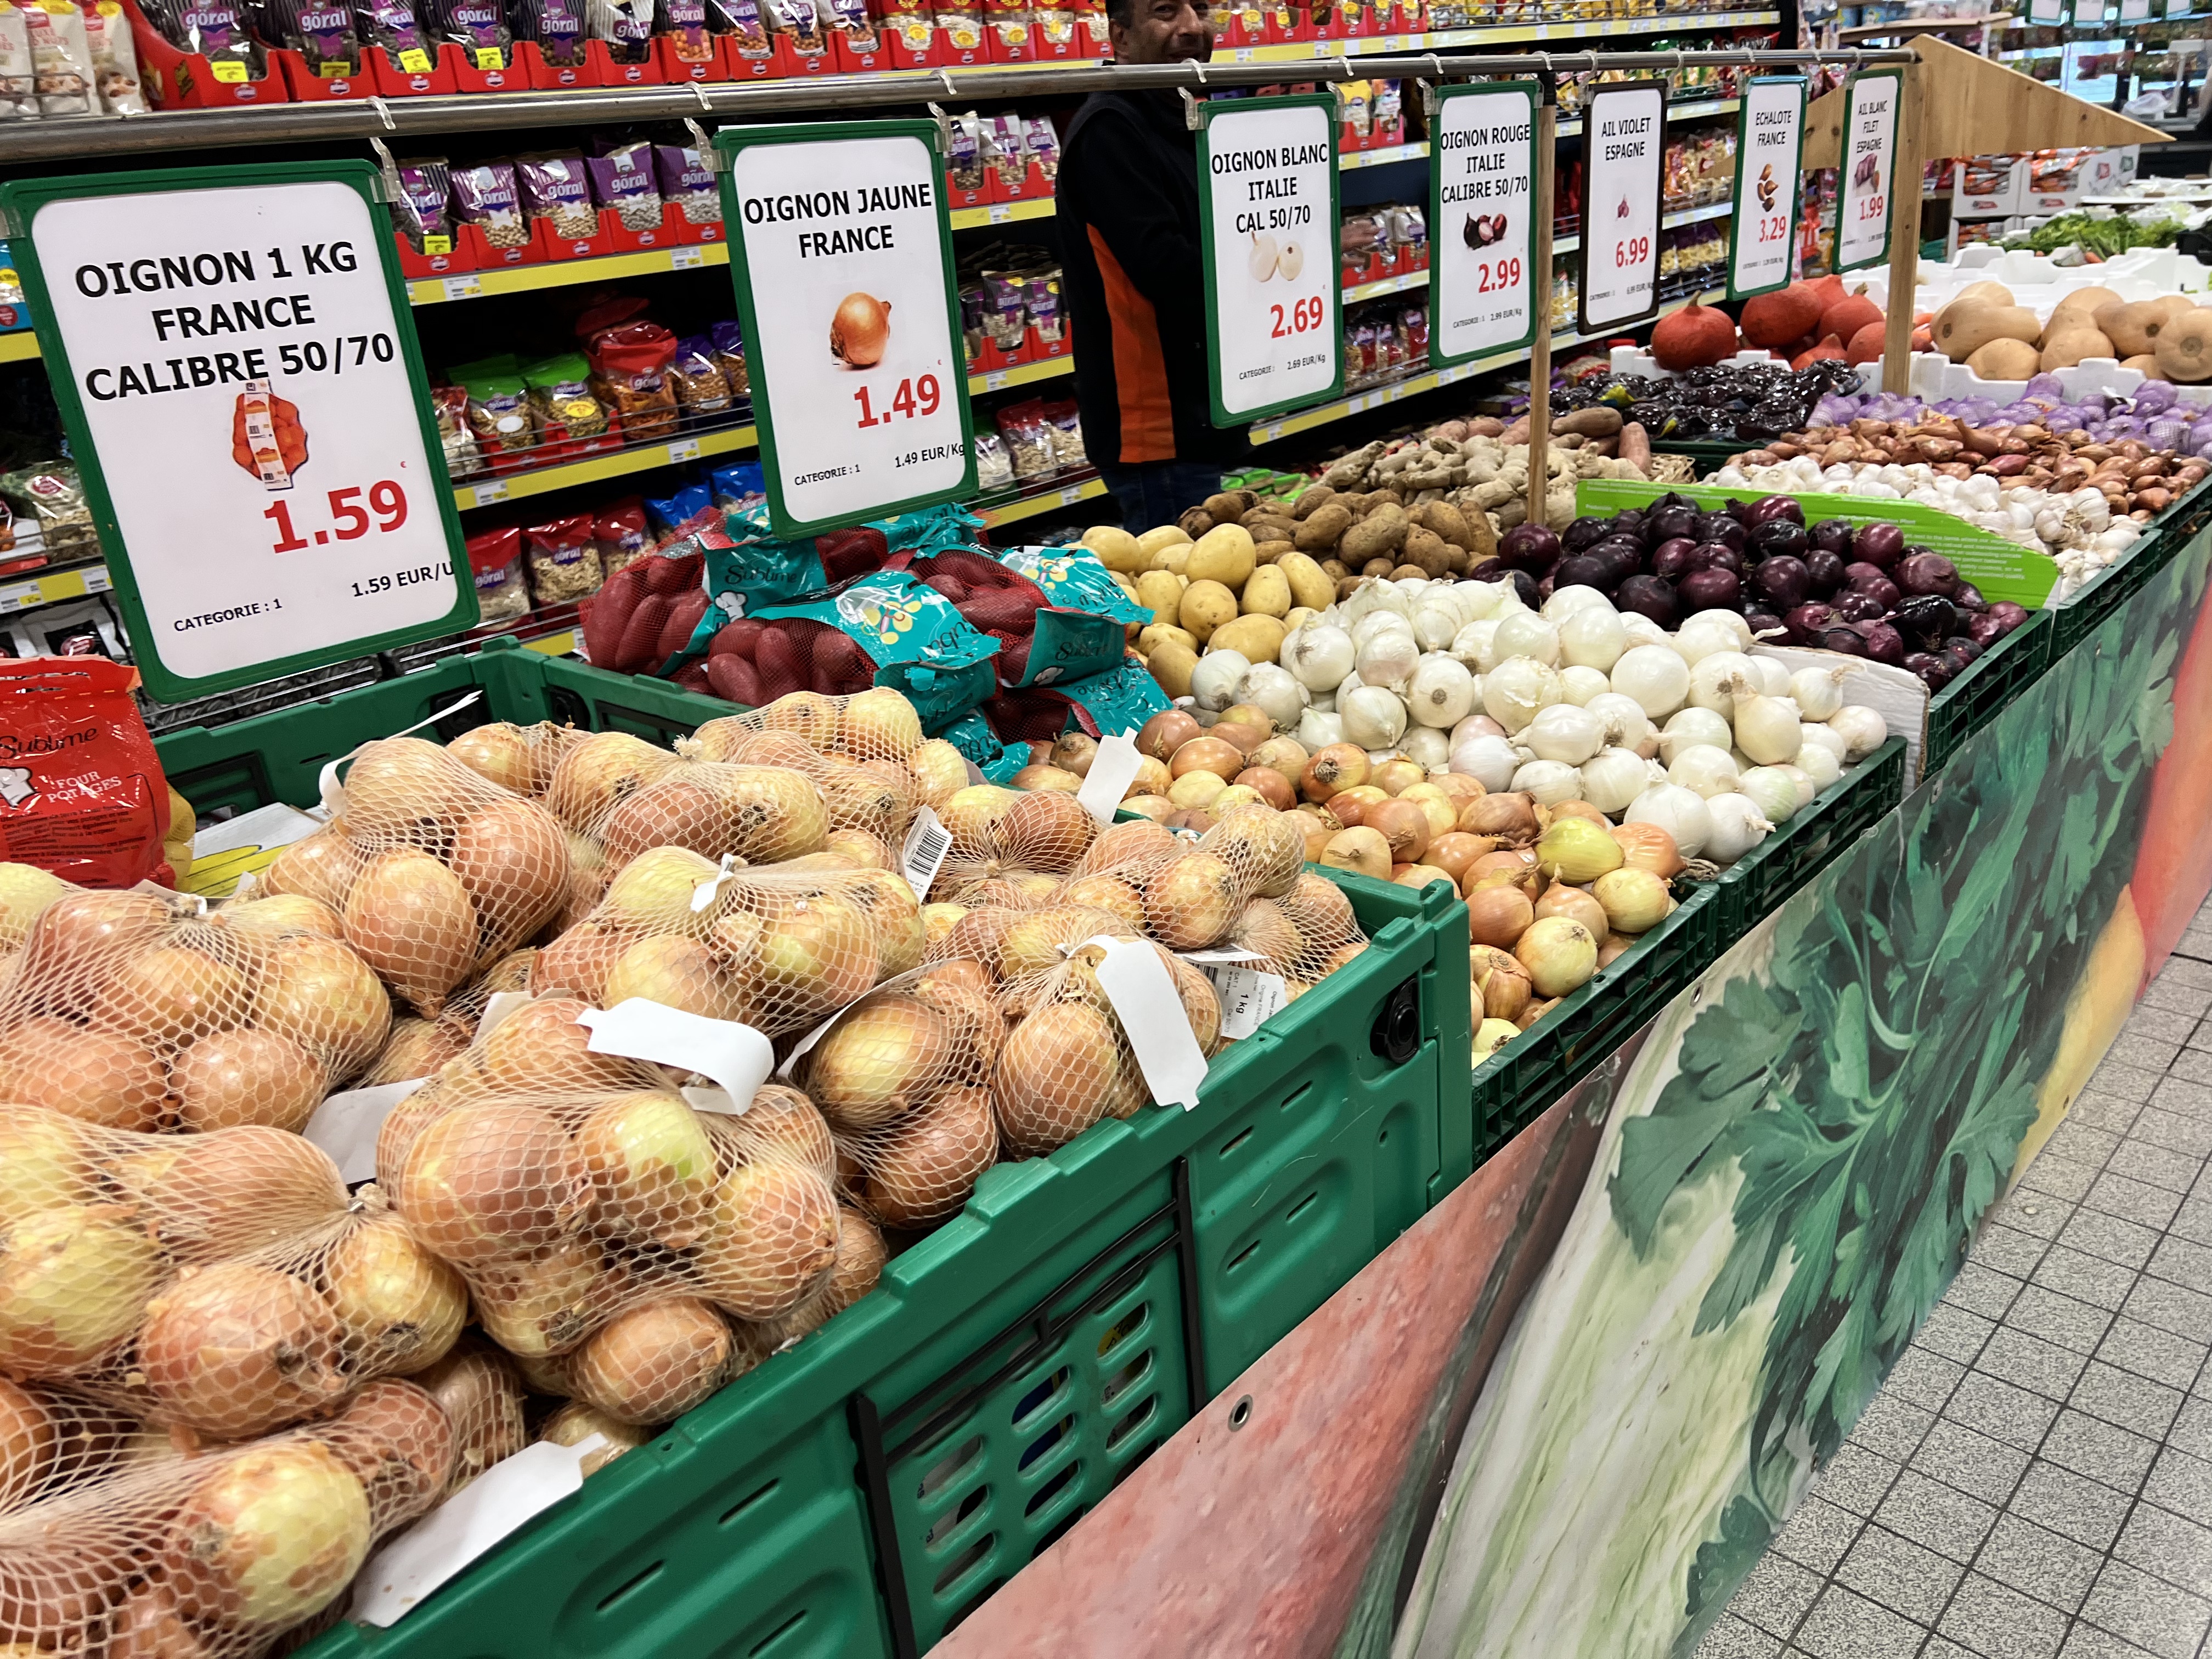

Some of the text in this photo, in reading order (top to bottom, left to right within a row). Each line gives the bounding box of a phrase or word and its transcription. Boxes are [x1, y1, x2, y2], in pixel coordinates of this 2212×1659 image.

[1756, 110, 1792, 126] ECHALOTE
[1858, 100, 1888, 115] AIL BLANC
[1441, 124, 1531, 150] OIGNON ROUGE
[1601, 117, 1651, 137] AIL VIOLET
[1758, 131, 1786, 146] FRANCE
[1863, 120, 1879, 133] FILET
[1211, 143, 1328, 174] OIGNON BLANC
[1606, 141, 1645, 161] ESPAGNE
[1857, 138, 1882, 154] ESPAGNE
[1466, 153, 1505, 174] ITALIE
[1248, 177, 1297, 201] ITALIE
[1441, 176, 1528, 204] CALIBRE 50/70
[744, 183, 932, 224] OIGNON JAUNE
[1860, 195, 1884, 221] 1.99
[1236, 205, 1310, 234] CAL 50/70
[1759, 216, 1787, 242] 3.29
[798, 224, 894, 258] FRANCE
[1616, 236, 1649, 268] 6.99
[75, 241, 357, 298] OIGNON 1 KG
[1479, 257, 1521, 294] 2.99
[151, 294, 315, 341] FRANCE
[1271, 296, 1324, 338] 2.69
[86, 333, 393, 402] CALIBRE 50/70
[1239, 365, 1272, 380] CATEGORIE
[1287, 354, 1325, 370] 2.69 EUR/Kg
[854, 374, 940, 428] 1.49
[895, 452, 918, 468] 1.49
[794, 466, 847, 486] CATEGORIE
[263, 479, 408, 554] 1.59
[351, 575, 391, 597] 1.59
[174, 603, 261, 631] CATEGORIE
[47, 776, 122, 803] POTAGES
[56, 771, 101, 789] FOUR
[1235, 1002, 1248, 1014] kg
